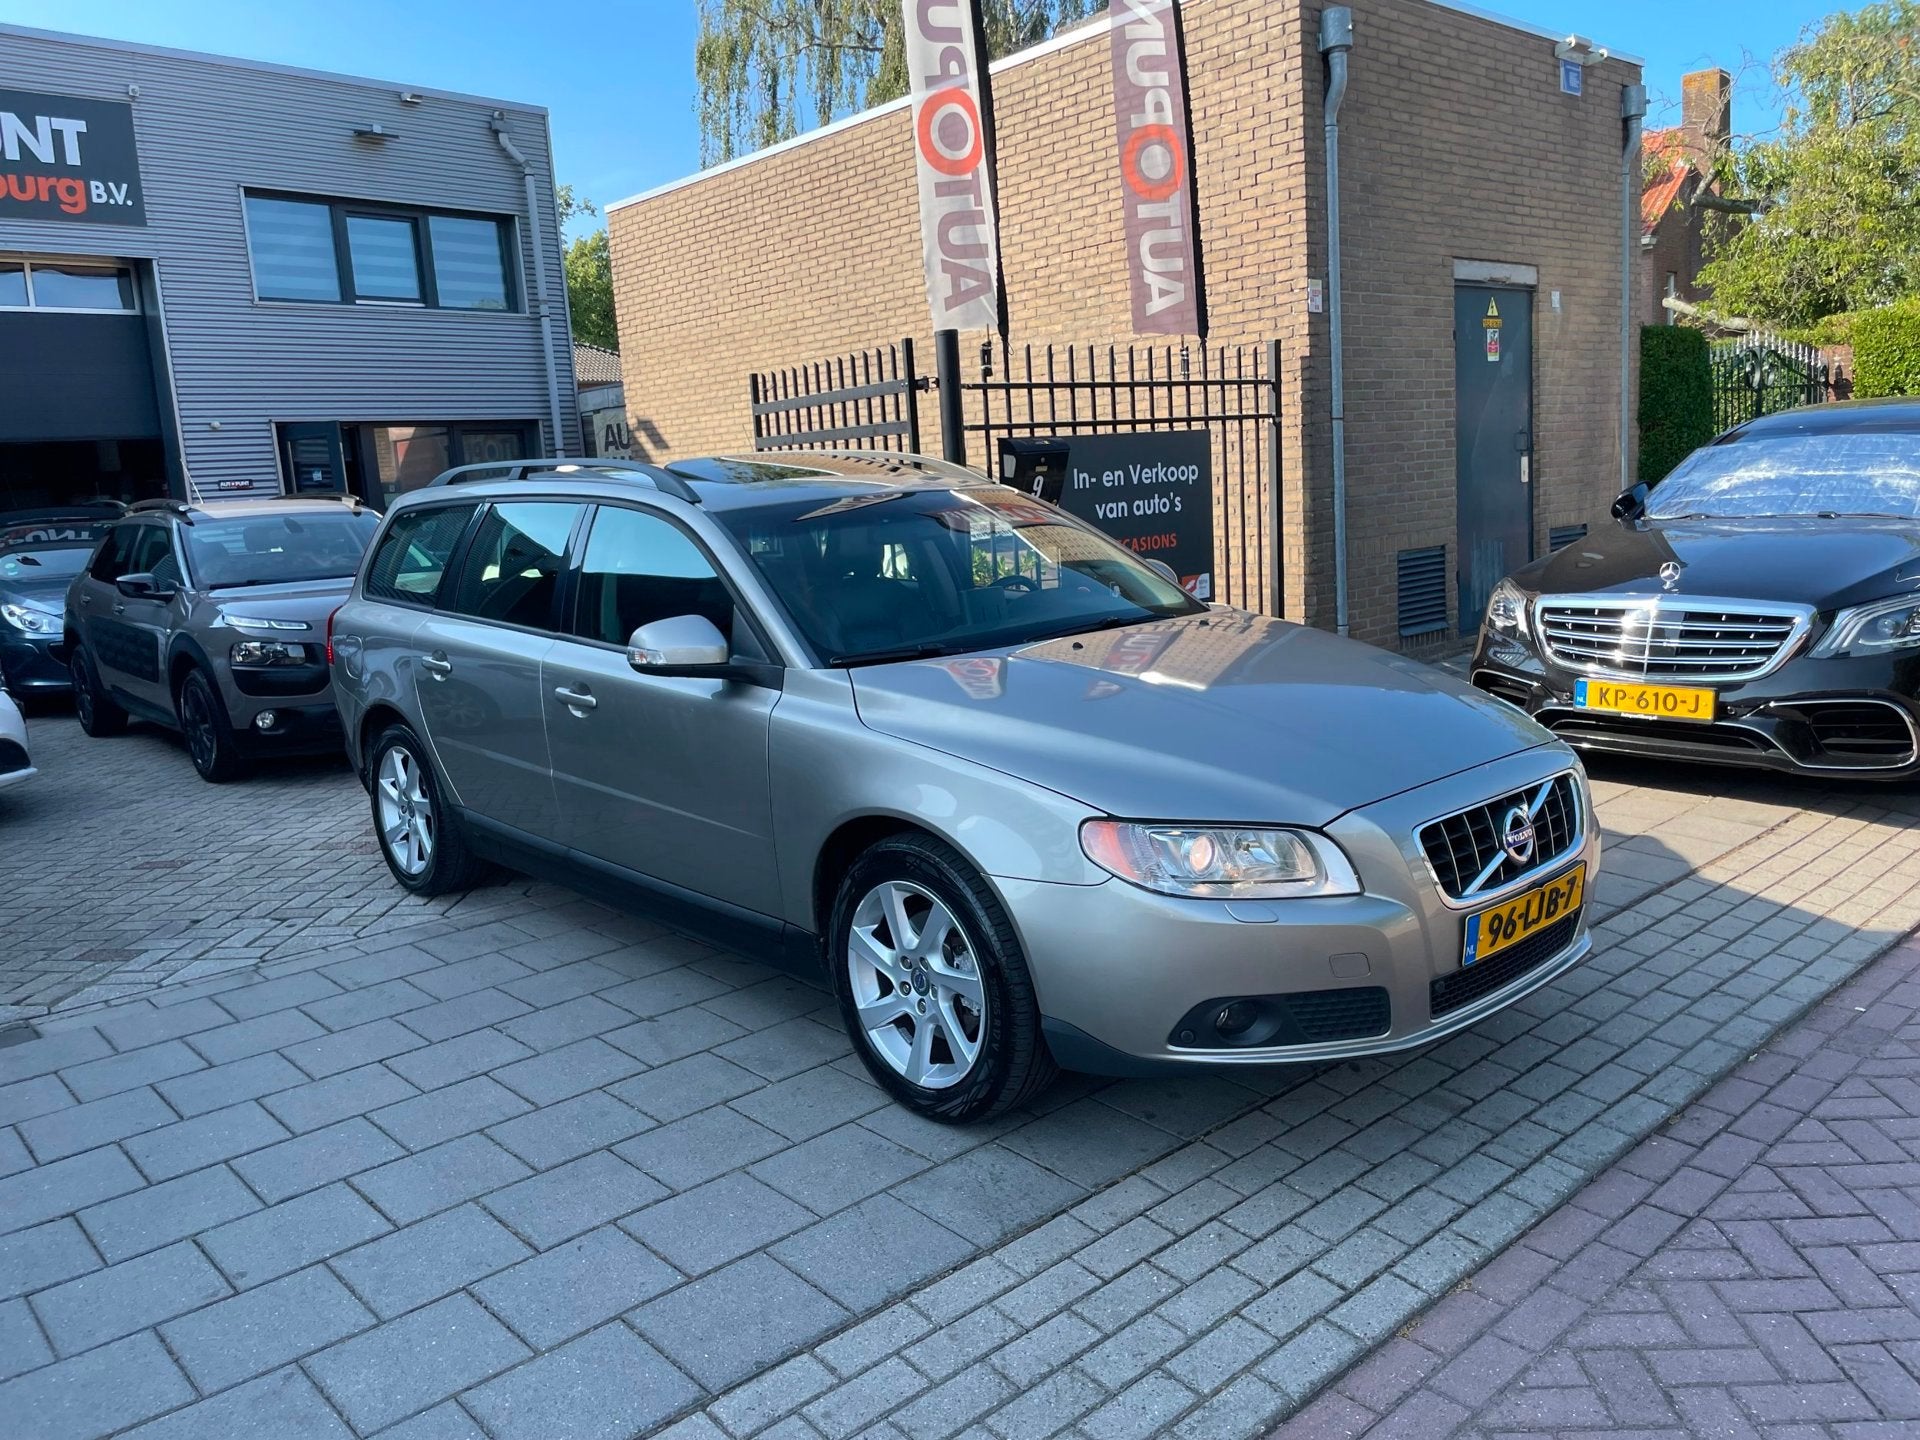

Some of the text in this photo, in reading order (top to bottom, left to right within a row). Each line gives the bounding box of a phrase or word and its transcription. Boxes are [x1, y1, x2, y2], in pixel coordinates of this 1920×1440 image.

[0, 112, 87, 166] NT
[90, 180, 133, 206] B.V.
[1030, 475, 1044, 498] 9
[1073, 462, 1199, 489] In- en Verkoop
[1095, 492, 1182, 519] van auto's
[1118, 533, 1177, 552] ASIONS
[1599, 687, 1700, 713] KP-610-J
[1506, 828, 1533, 844] VOLVO
[1488, 875, 1578, 948] 96-LJB-7
[1465, 946, 1475, 955] NL
